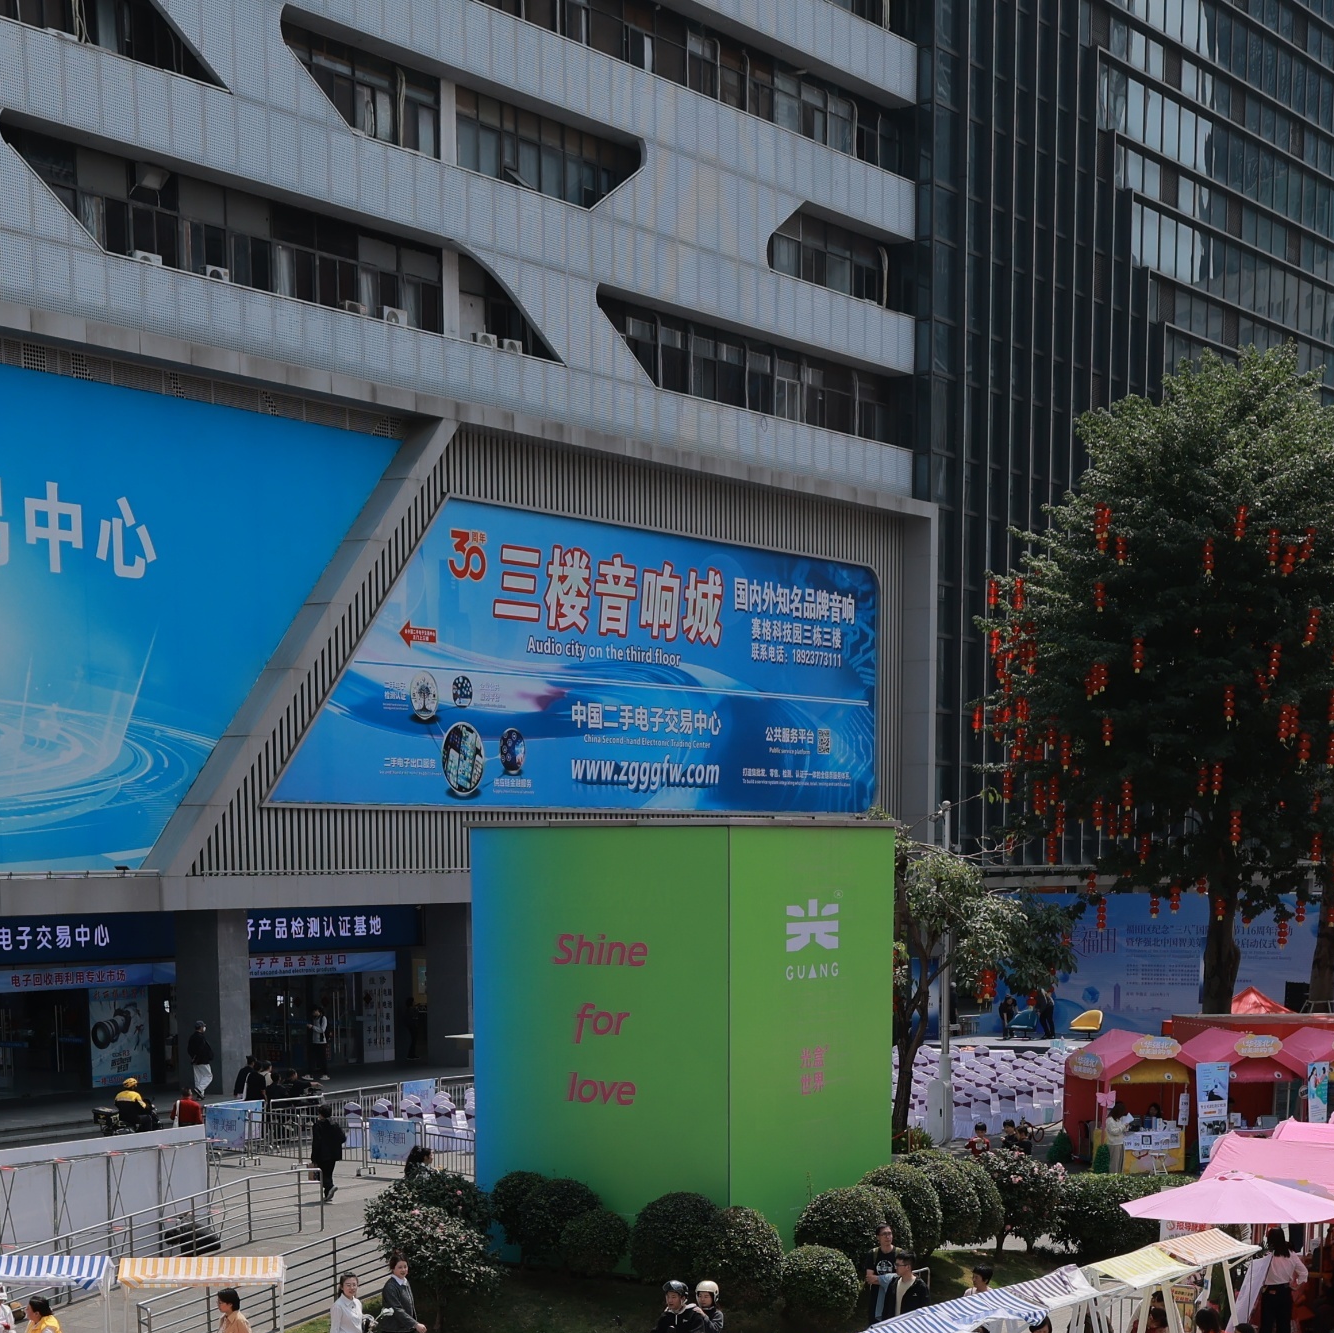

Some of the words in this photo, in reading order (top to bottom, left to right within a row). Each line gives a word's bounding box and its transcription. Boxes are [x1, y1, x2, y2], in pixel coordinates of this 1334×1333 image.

[471, 531, 487, 545] 周年
[493, 543, 725, 648] 三楼音响城
[734, 577, 856, 625] 国内外知名品牌音响
[751, 617, 842, 650] 赛格科技园三栋三楼
[526, 635, 563, 657] Audio
[565, 639, 587, 662] city
[588, 646, 604, 659] on
[605, 643, 624, 661] the
[625, 646, 653, 665] third
[654, 648, 681, 667] floor
[571, 700, 722, 736] 中国二手电子交易中心
[583, 733, 602, 744] China
[602, 734, 641, 746] Second-hand
[641, 737, 670, 747] Electronic
[670, 738, 692, 750] Trading
[692, 740, 711, 750] Center
[765, 726, 815, 745] 公共服务平台
[571, 754, 720, 790] www.zgggfw.com
[248, 953, 347, 970] 子产品合法出口
[551, 933, 649, 967] Shine
[11, 969, 127, 988] 电子回收再利用专业市场
[785, 961, 839, 981] GUANG
[571, 1002, 630, 1045] for
[565, 1071, 637, 1106] love
[800, 1071, 825, 1095] 世界
